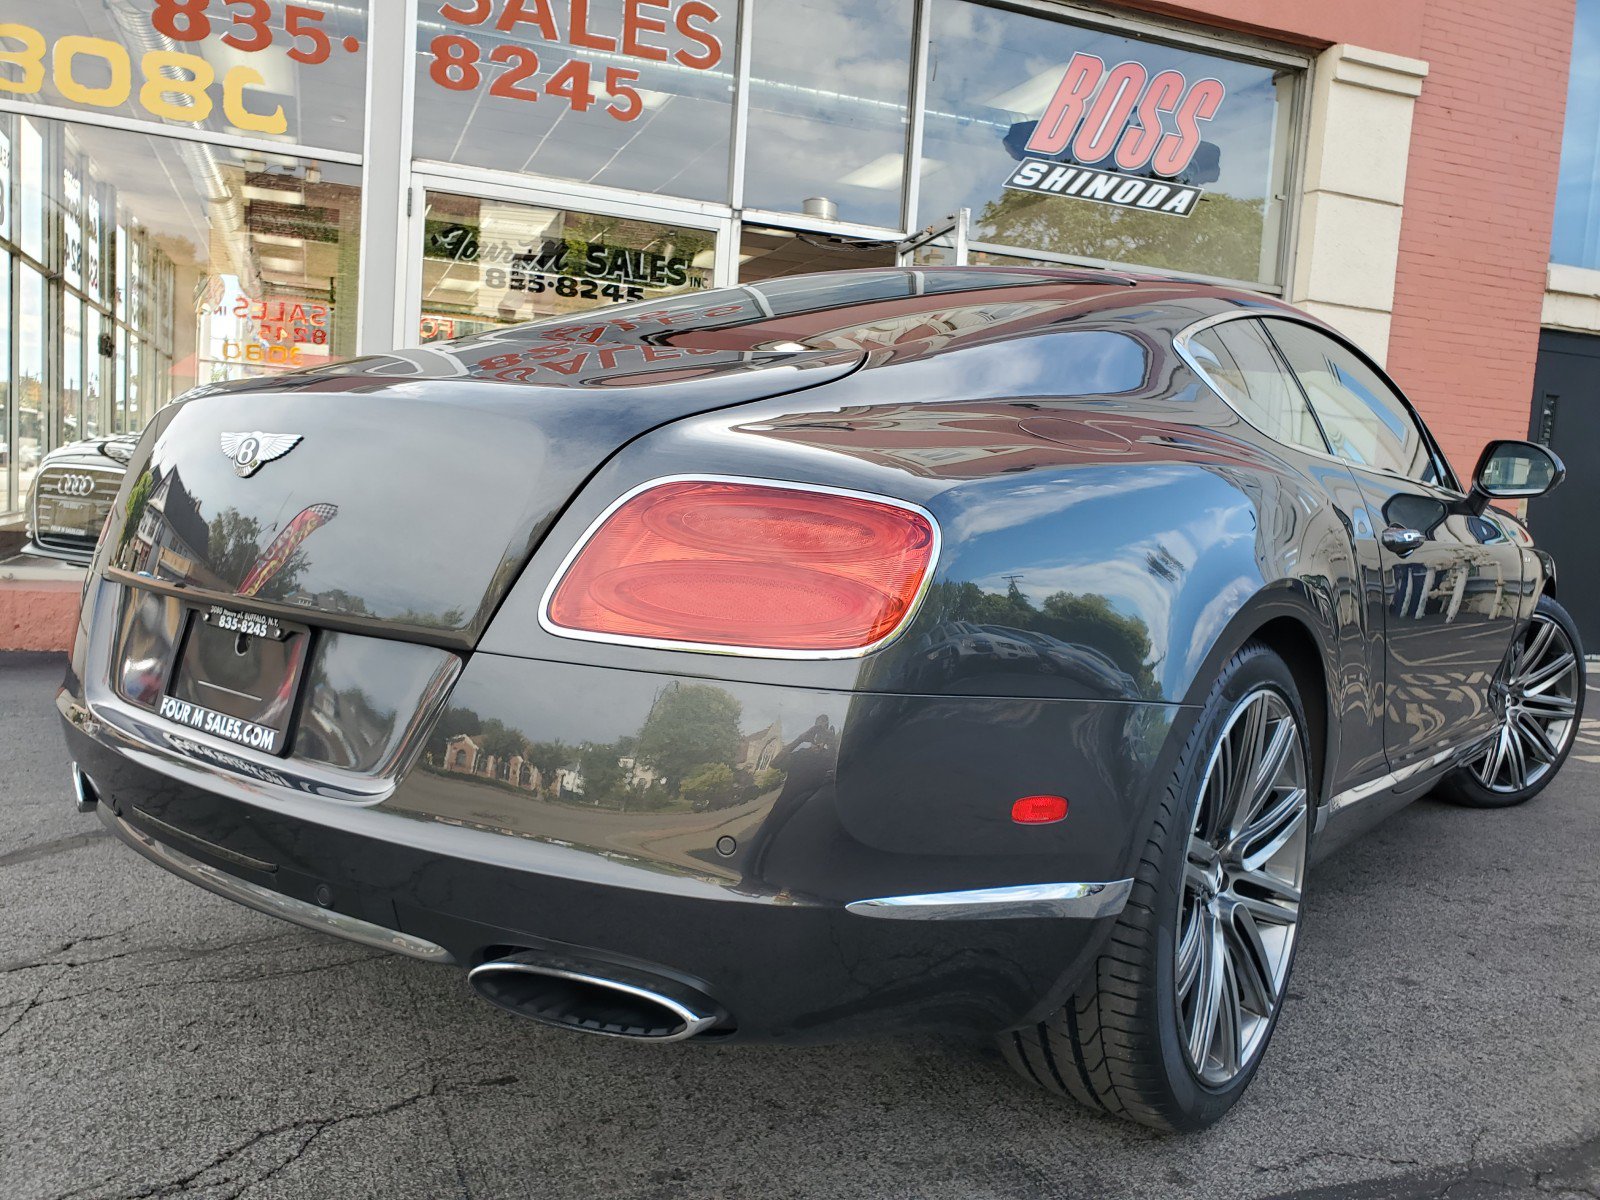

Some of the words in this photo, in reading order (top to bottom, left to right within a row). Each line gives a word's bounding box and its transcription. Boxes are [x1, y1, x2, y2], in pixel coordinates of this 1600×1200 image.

[429, 34, 644, 122] 8245
[1024, 51, 1226, 177] BOSS
[1012, 161, 1197, 214] SHINODA
[585, 243, 689, 288] SALES
[159, 697, 192, 724] FOUR
[191, 707, 205, 728] M
[204, 711, 276, 751] SALES.COM
